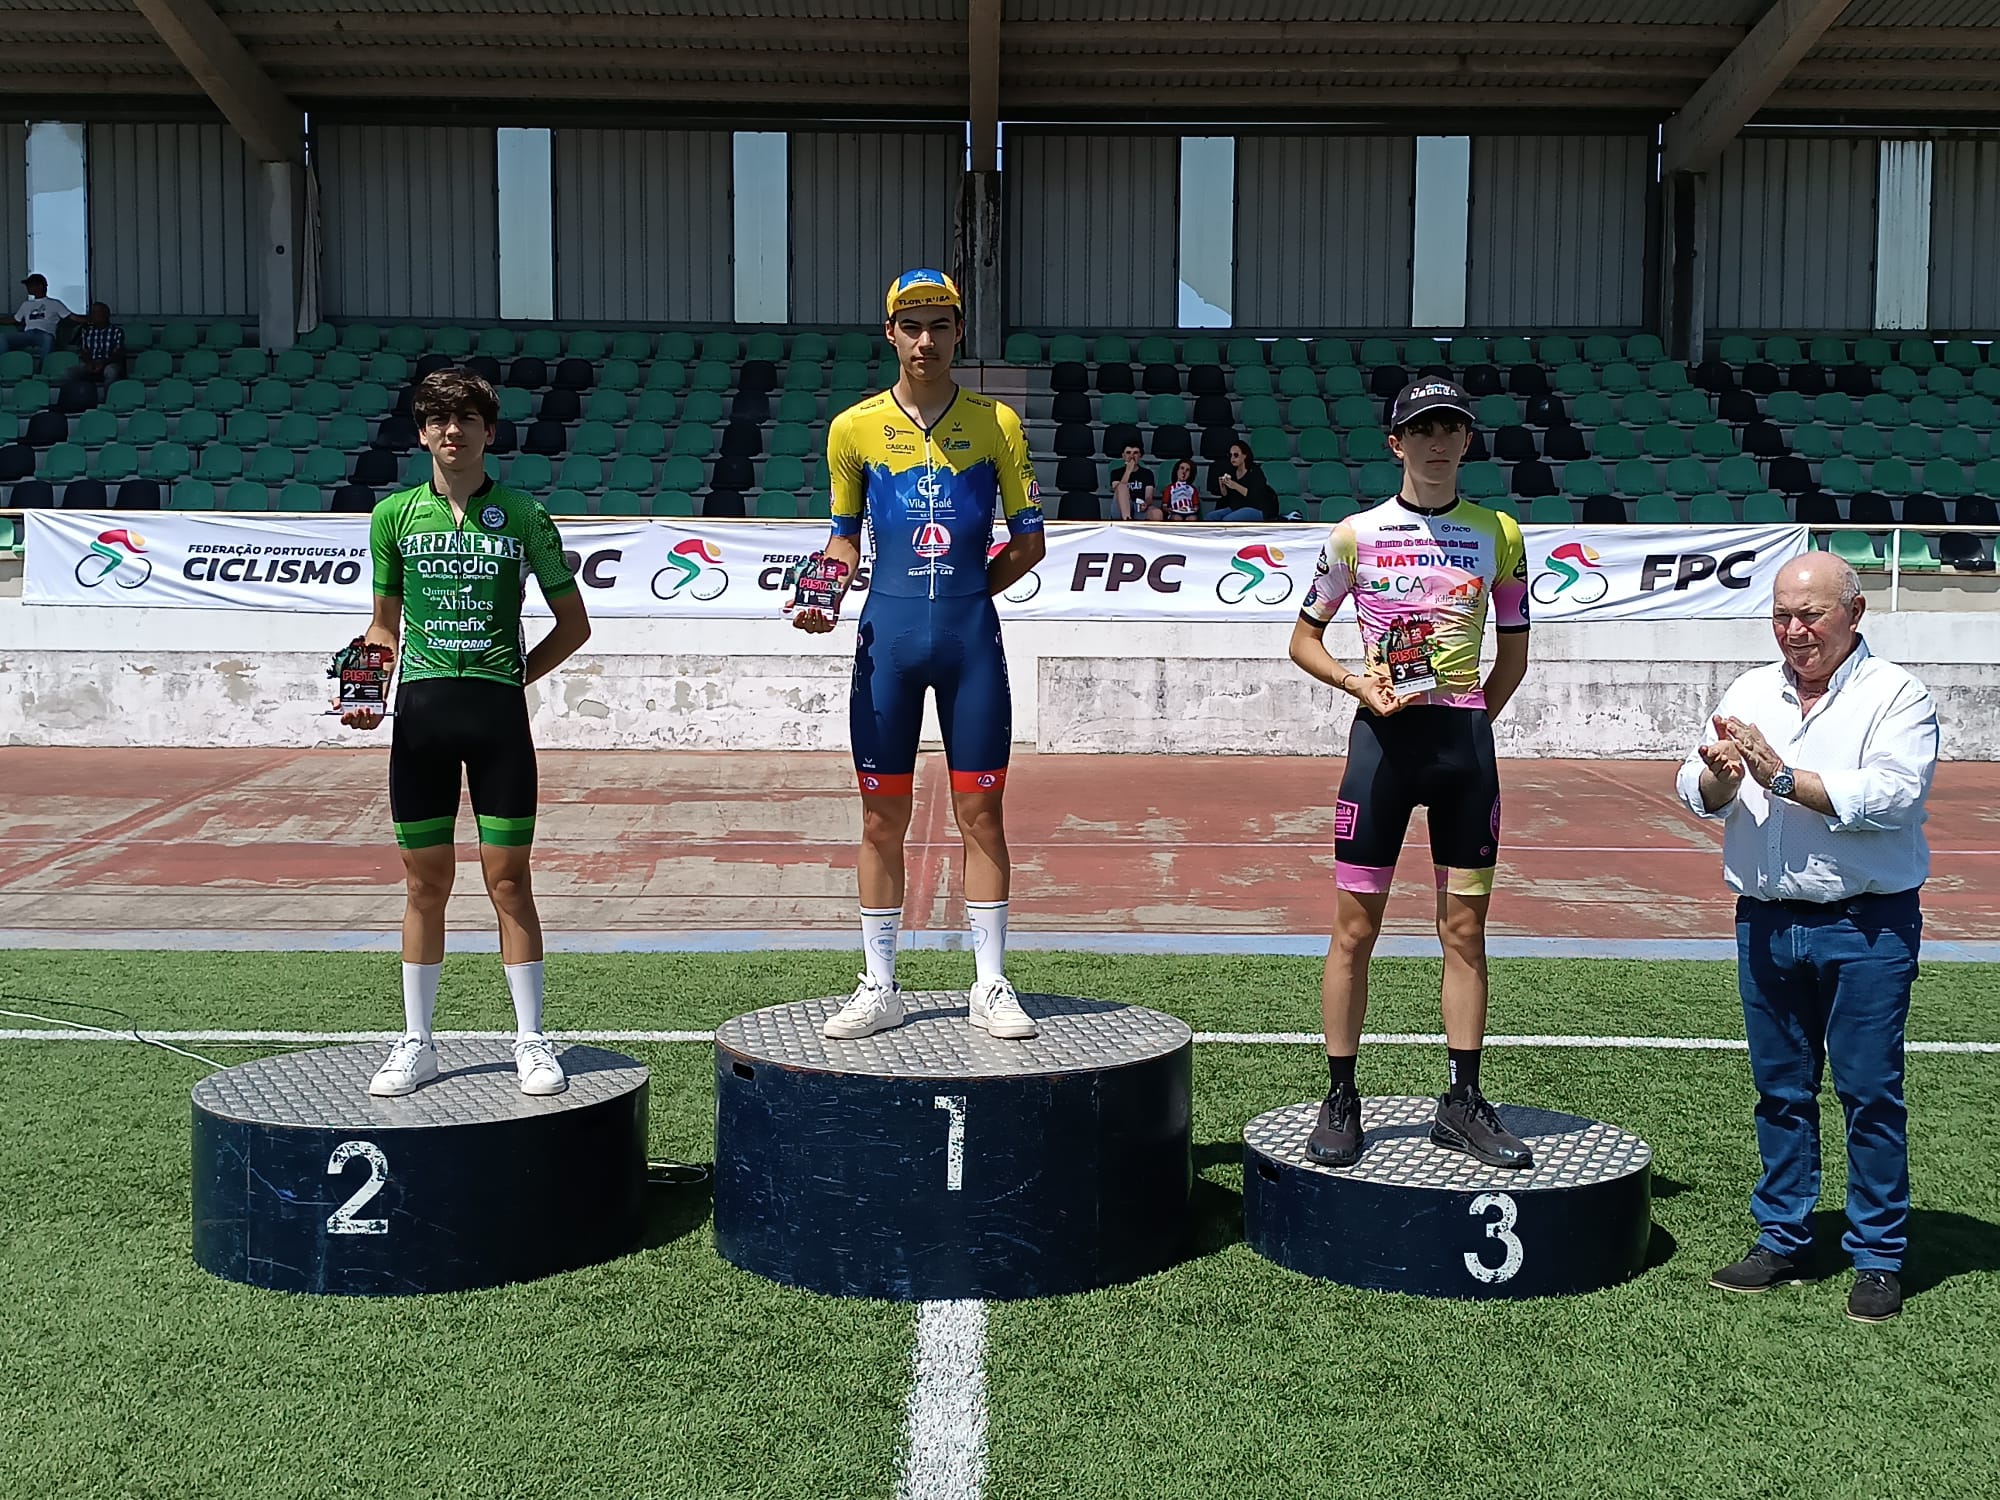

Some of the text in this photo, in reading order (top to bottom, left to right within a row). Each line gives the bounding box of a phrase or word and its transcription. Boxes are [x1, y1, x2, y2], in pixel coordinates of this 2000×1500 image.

[908, 498, 926, 508] Vila
[188, 544, 368, 557] FEDERAÇÃO PORTUGUESA DE
[1376, 554, 1476, 569] MATDIVER
[182, 557, 362, 585] CICLISMO
[417, 556, 499, 574] anadia
[1070, 552, 1187, 594] FPC
[1639, 550, 1757, 591] FPC
[1395, 576, 1426, 593] CA
[425, 617, 486, 633] primefix
[934, 1096, 967, 1190] 1
[327, 1141, 388, 1234] 2
[1464, 1192, 1524, 1283] 3
